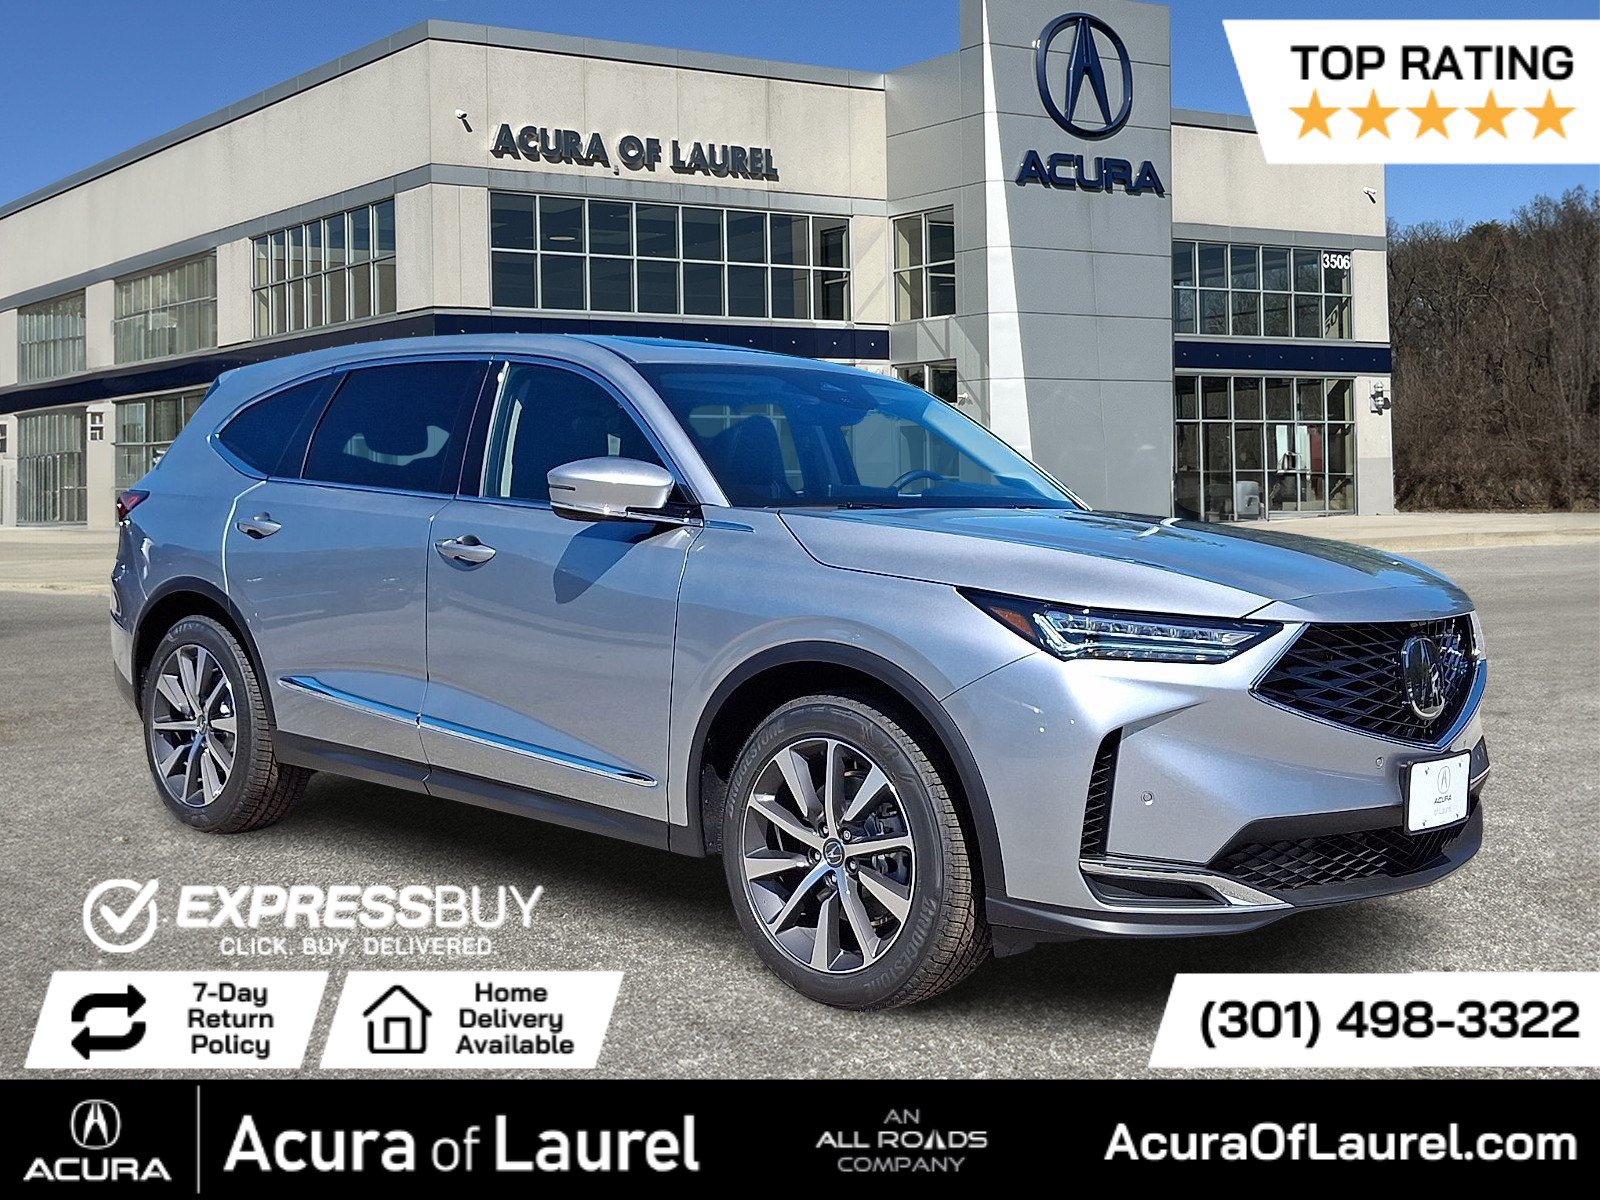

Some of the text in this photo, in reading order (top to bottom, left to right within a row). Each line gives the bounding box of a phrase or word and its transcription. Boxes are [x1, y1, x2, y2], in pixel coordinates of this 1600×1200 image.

[491, 123, 780, 181] ACURA OF LAUREL
[1016, 150, 1165, 198] ACURA
[1322, 253, 1351, 270] 3506
